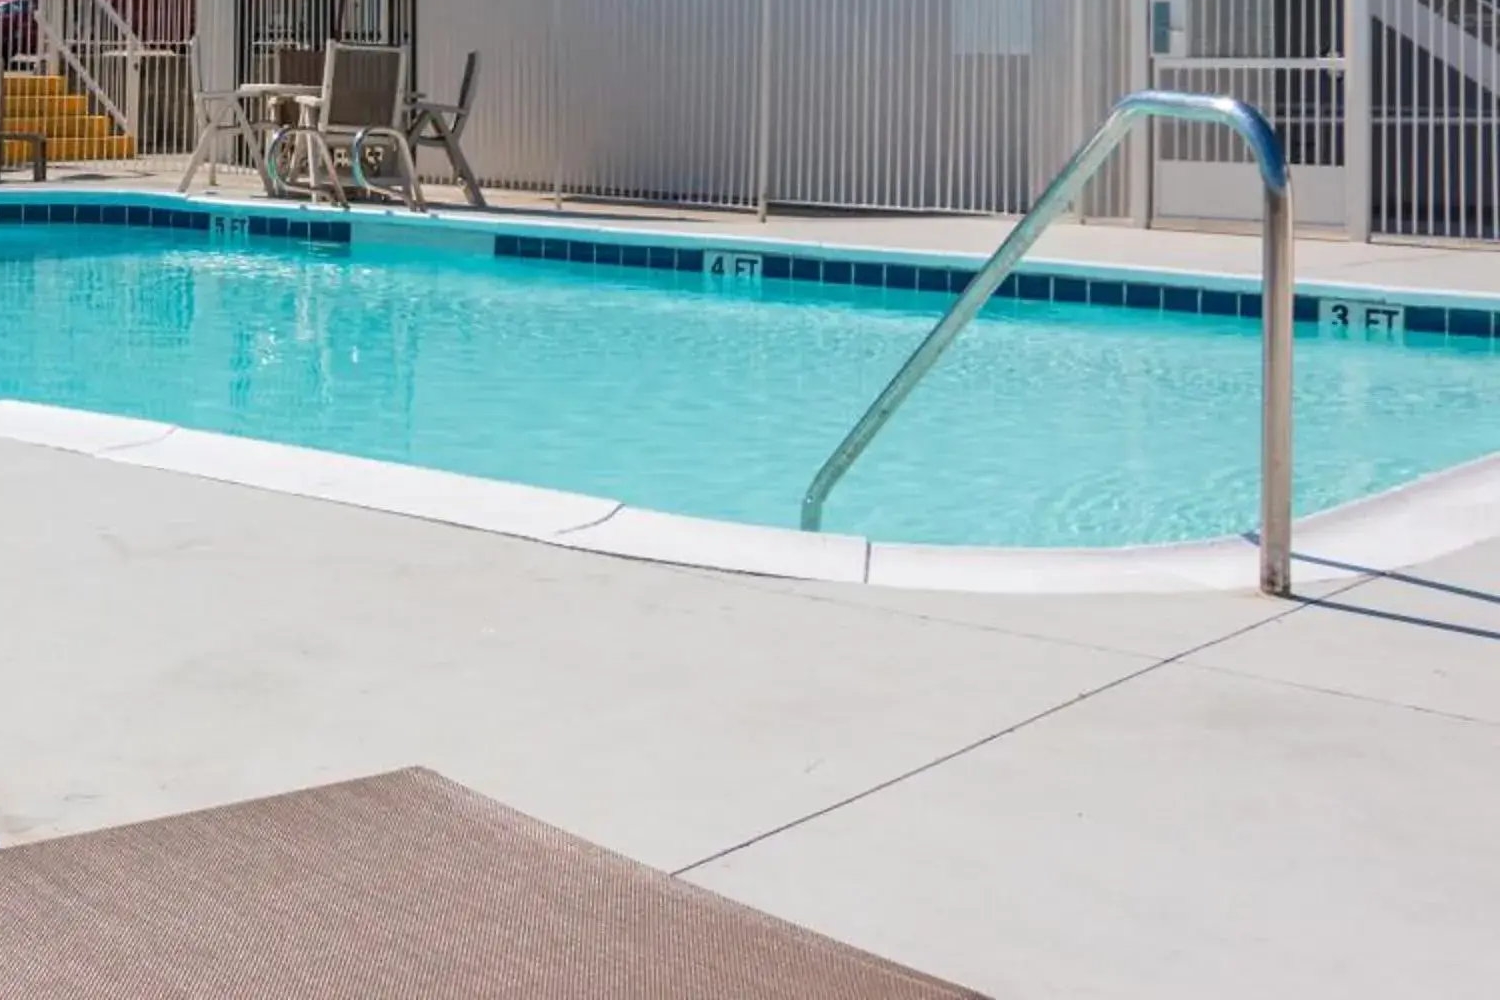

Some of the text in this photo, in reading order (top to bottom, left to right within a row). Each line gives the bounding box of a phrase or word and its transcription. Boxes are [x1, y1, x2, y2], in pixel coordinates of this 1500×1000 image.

[710, 256, 759, 279] 4 FT
[1331, 304, 1399, 332] 3 FT
